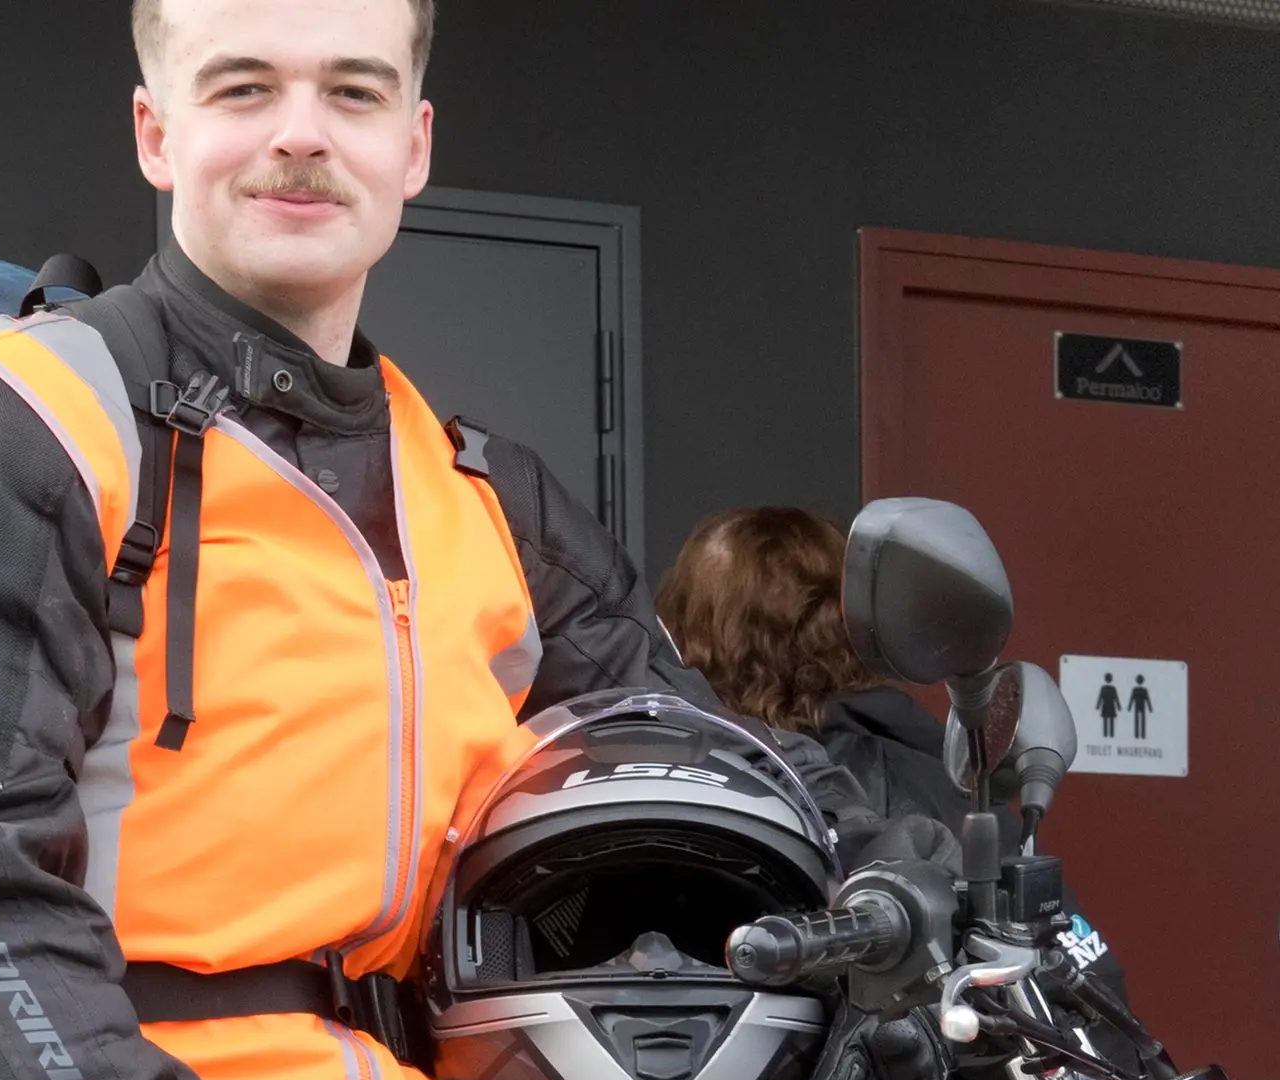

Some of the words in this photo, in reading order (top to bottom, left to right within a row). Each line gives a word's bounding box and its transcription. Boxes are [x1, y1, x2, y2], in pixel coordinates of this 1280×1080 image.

[1086, 744, 1112, 757] TOILET
[561, 763, 729, 788] LS2
[1067, 930, 1108, 970] NZ
